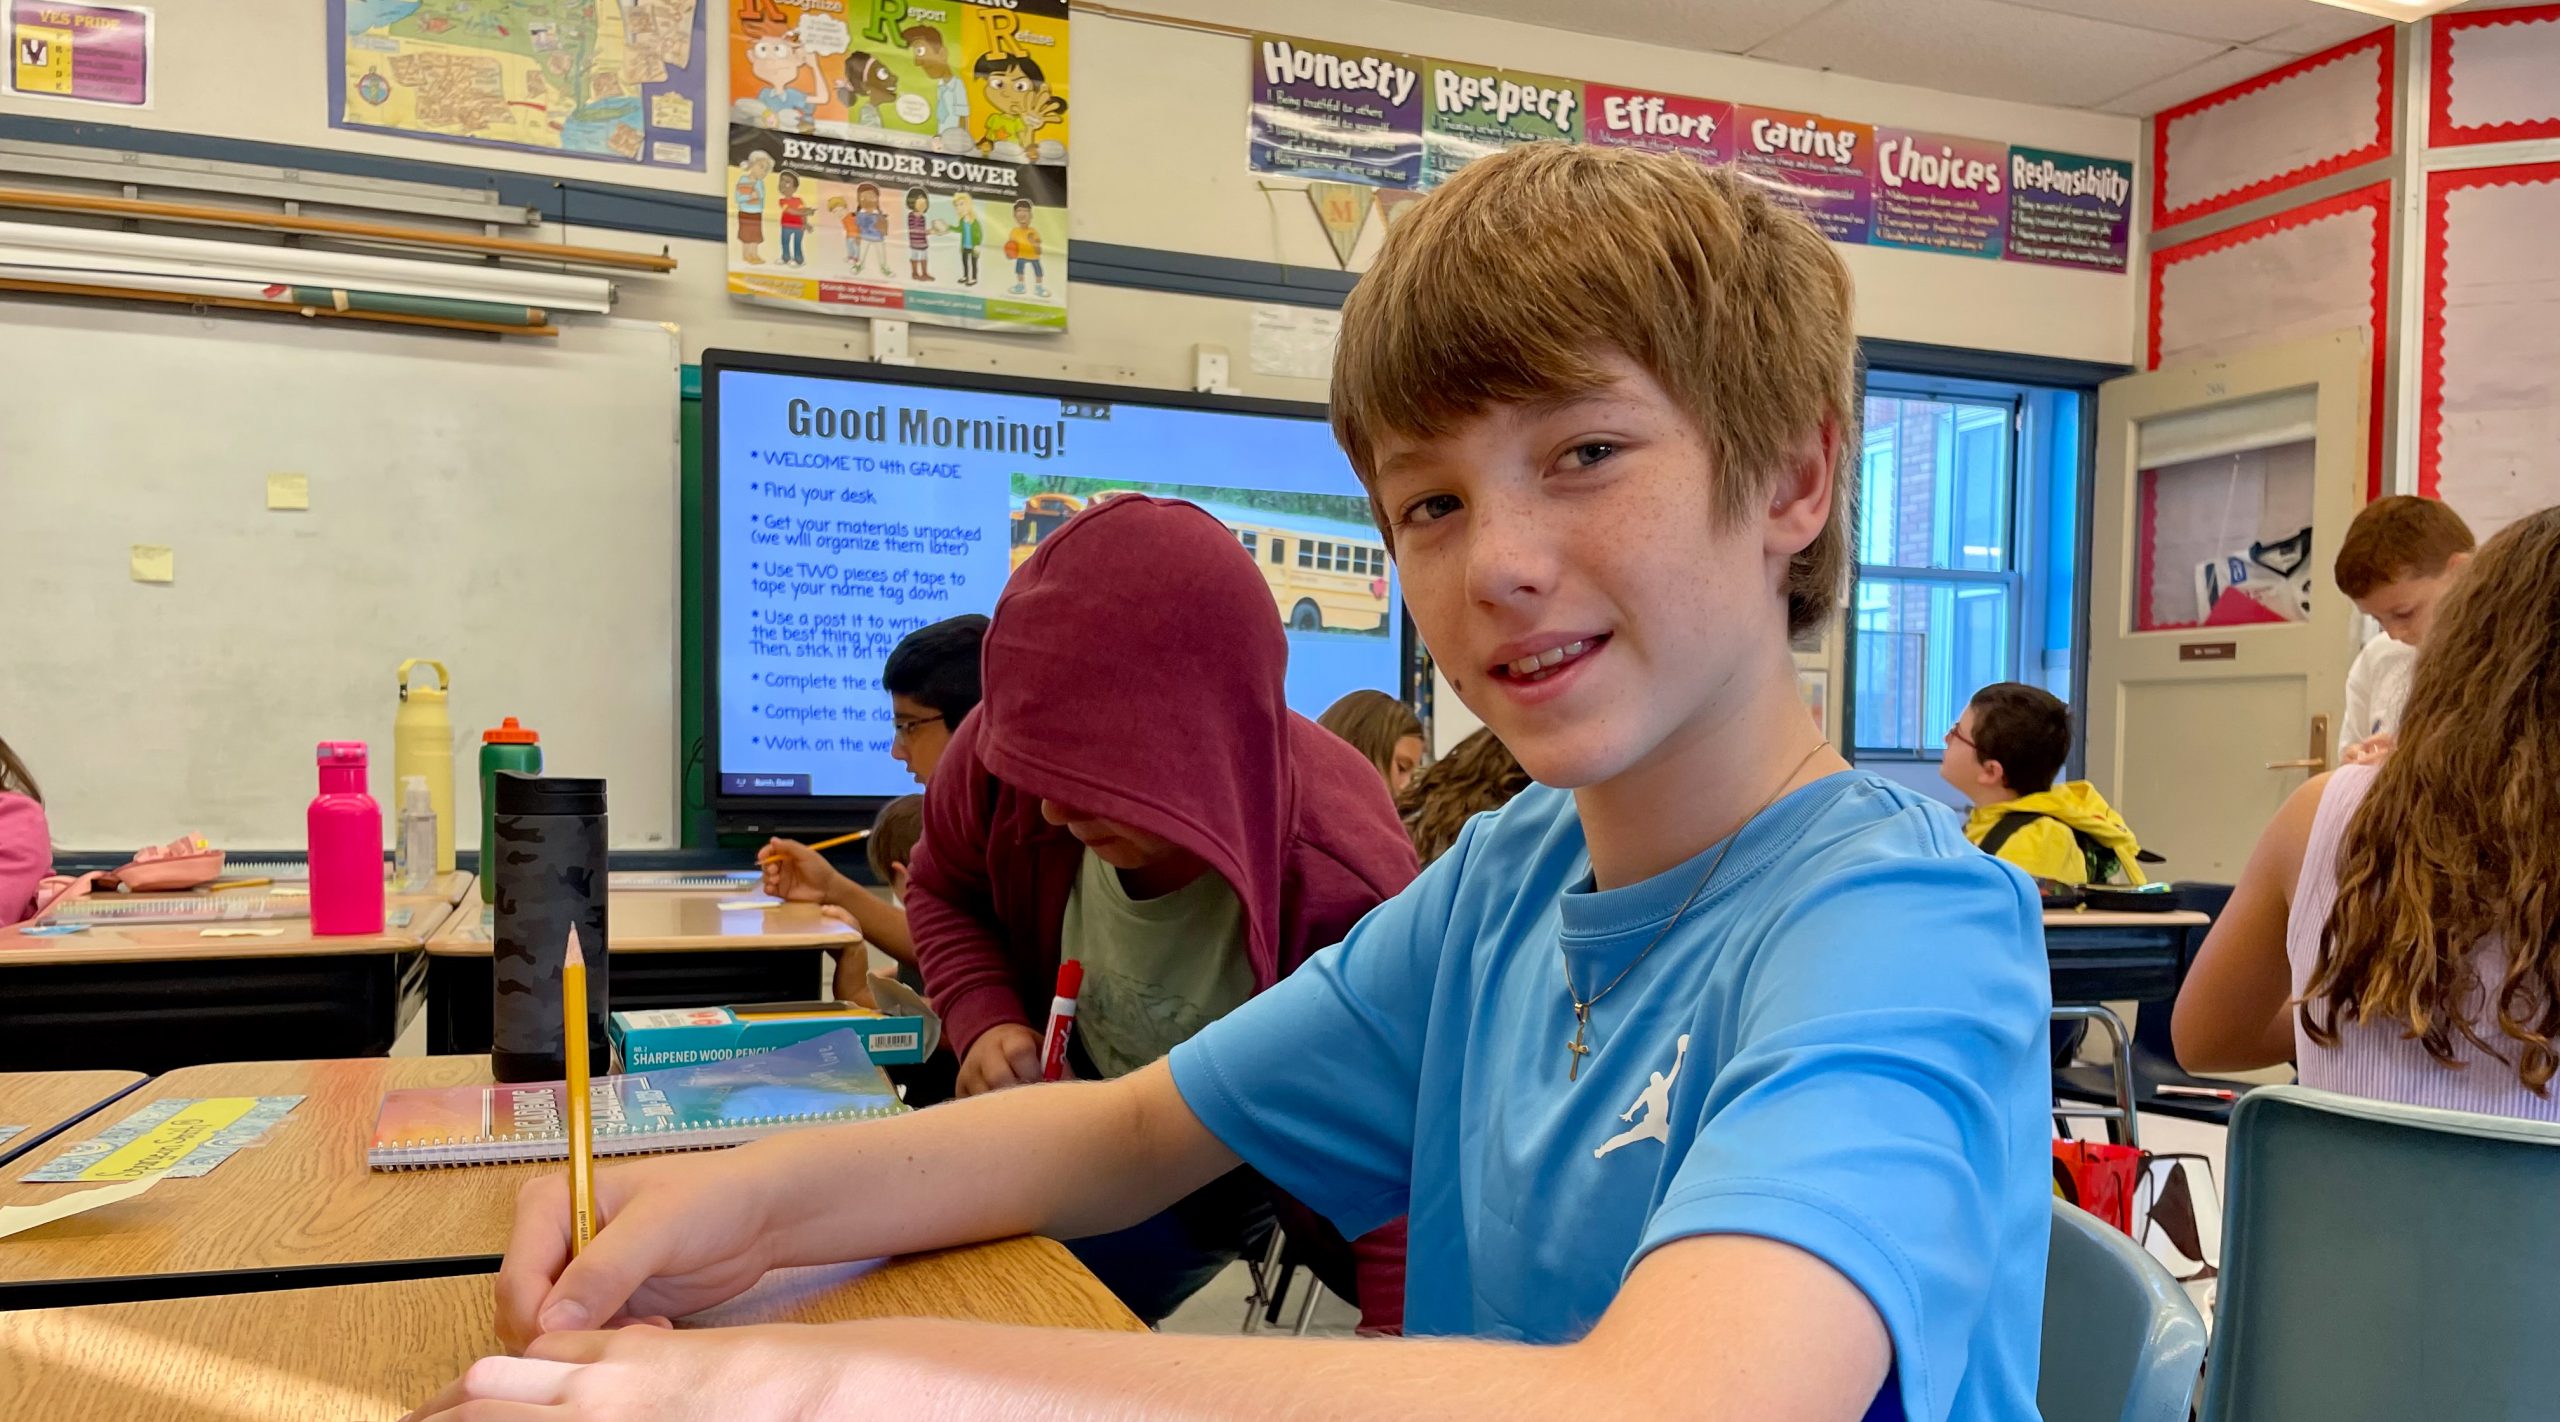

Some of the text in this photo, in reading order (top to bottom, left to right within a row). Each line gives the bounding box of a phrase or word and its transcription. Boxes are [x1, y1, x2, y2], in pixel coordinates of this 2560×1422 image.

[1263, 41, 1416, 106] Honesty
[1434, 69, 1577, 132] Respect
[1603, 96, 1716, 143] Effort
[1751, 117, 1856, 164] Caring
[782, 138, 1019, 187] BYSTANDER POWER
[1879, 136, 2000, 193] Choices
[1329, 200, 1355, 223] M
[788, 398, 1066, 459] Good Morning!
[763, 451, 962, 479] WELCOME TO 4th GRADE
[764, 482, 877, 507] Find your desk
[764, 515, 982, 543] Get your materials unpacked
[752, 529, 969, 557] (we will organize them later)
[764, 562, 966, 587] Use TWO pieces of tape to
[752, 579, 949, 605] tape your name tag down
[764, 609, 928, 632] Use a post it to write
[752, 625, 892, 648] the best thing you
[796, 643, 833, 658] stick
[837, 644, 848, 659] it
[853, 646, 872, 659] on
[765, 672, 837, 693] Complete
[842, 674, 867, 689] the
[765, 704, 837, 725] Complete
[842, 706, 867, 721] the
[764, 735, 810, 752] Work
[815, 738, 834, 751] on
[840, 737, 864, 752] the
[633, 1050, 698, 1065] SHARPENED
[699, 1048, 733, 1062] WOOD
[511, 1088, 561, 1132] ACADEMIC
